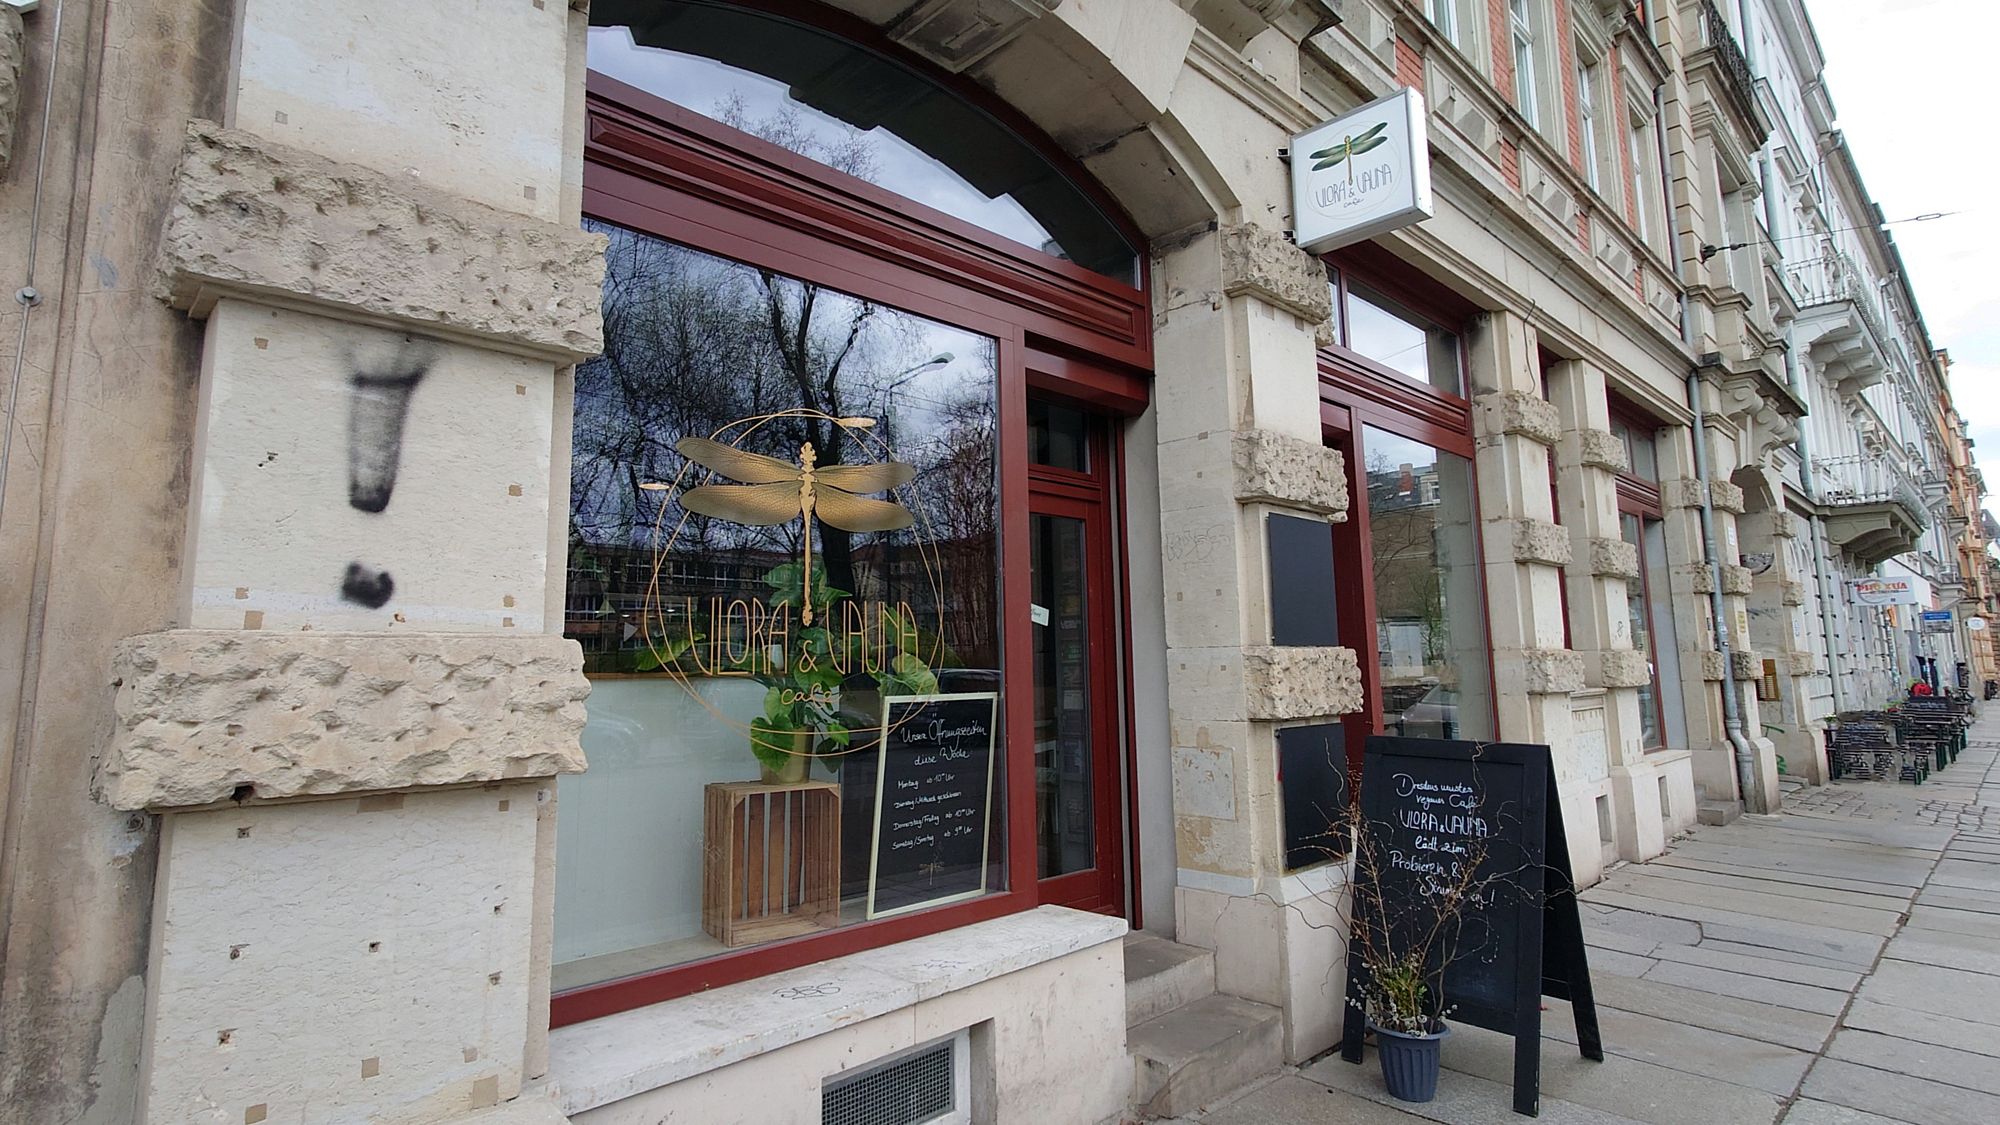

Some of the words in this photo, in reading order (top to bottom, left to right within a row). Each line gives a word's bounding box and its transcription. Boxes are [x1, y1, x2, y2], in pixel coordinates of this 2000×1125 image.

[1348, 188, 1355, 198] &
[800, 640, 818, 672] &
[914, 755, 937, 766] diese
[1451, 861, 1462, 879] &
